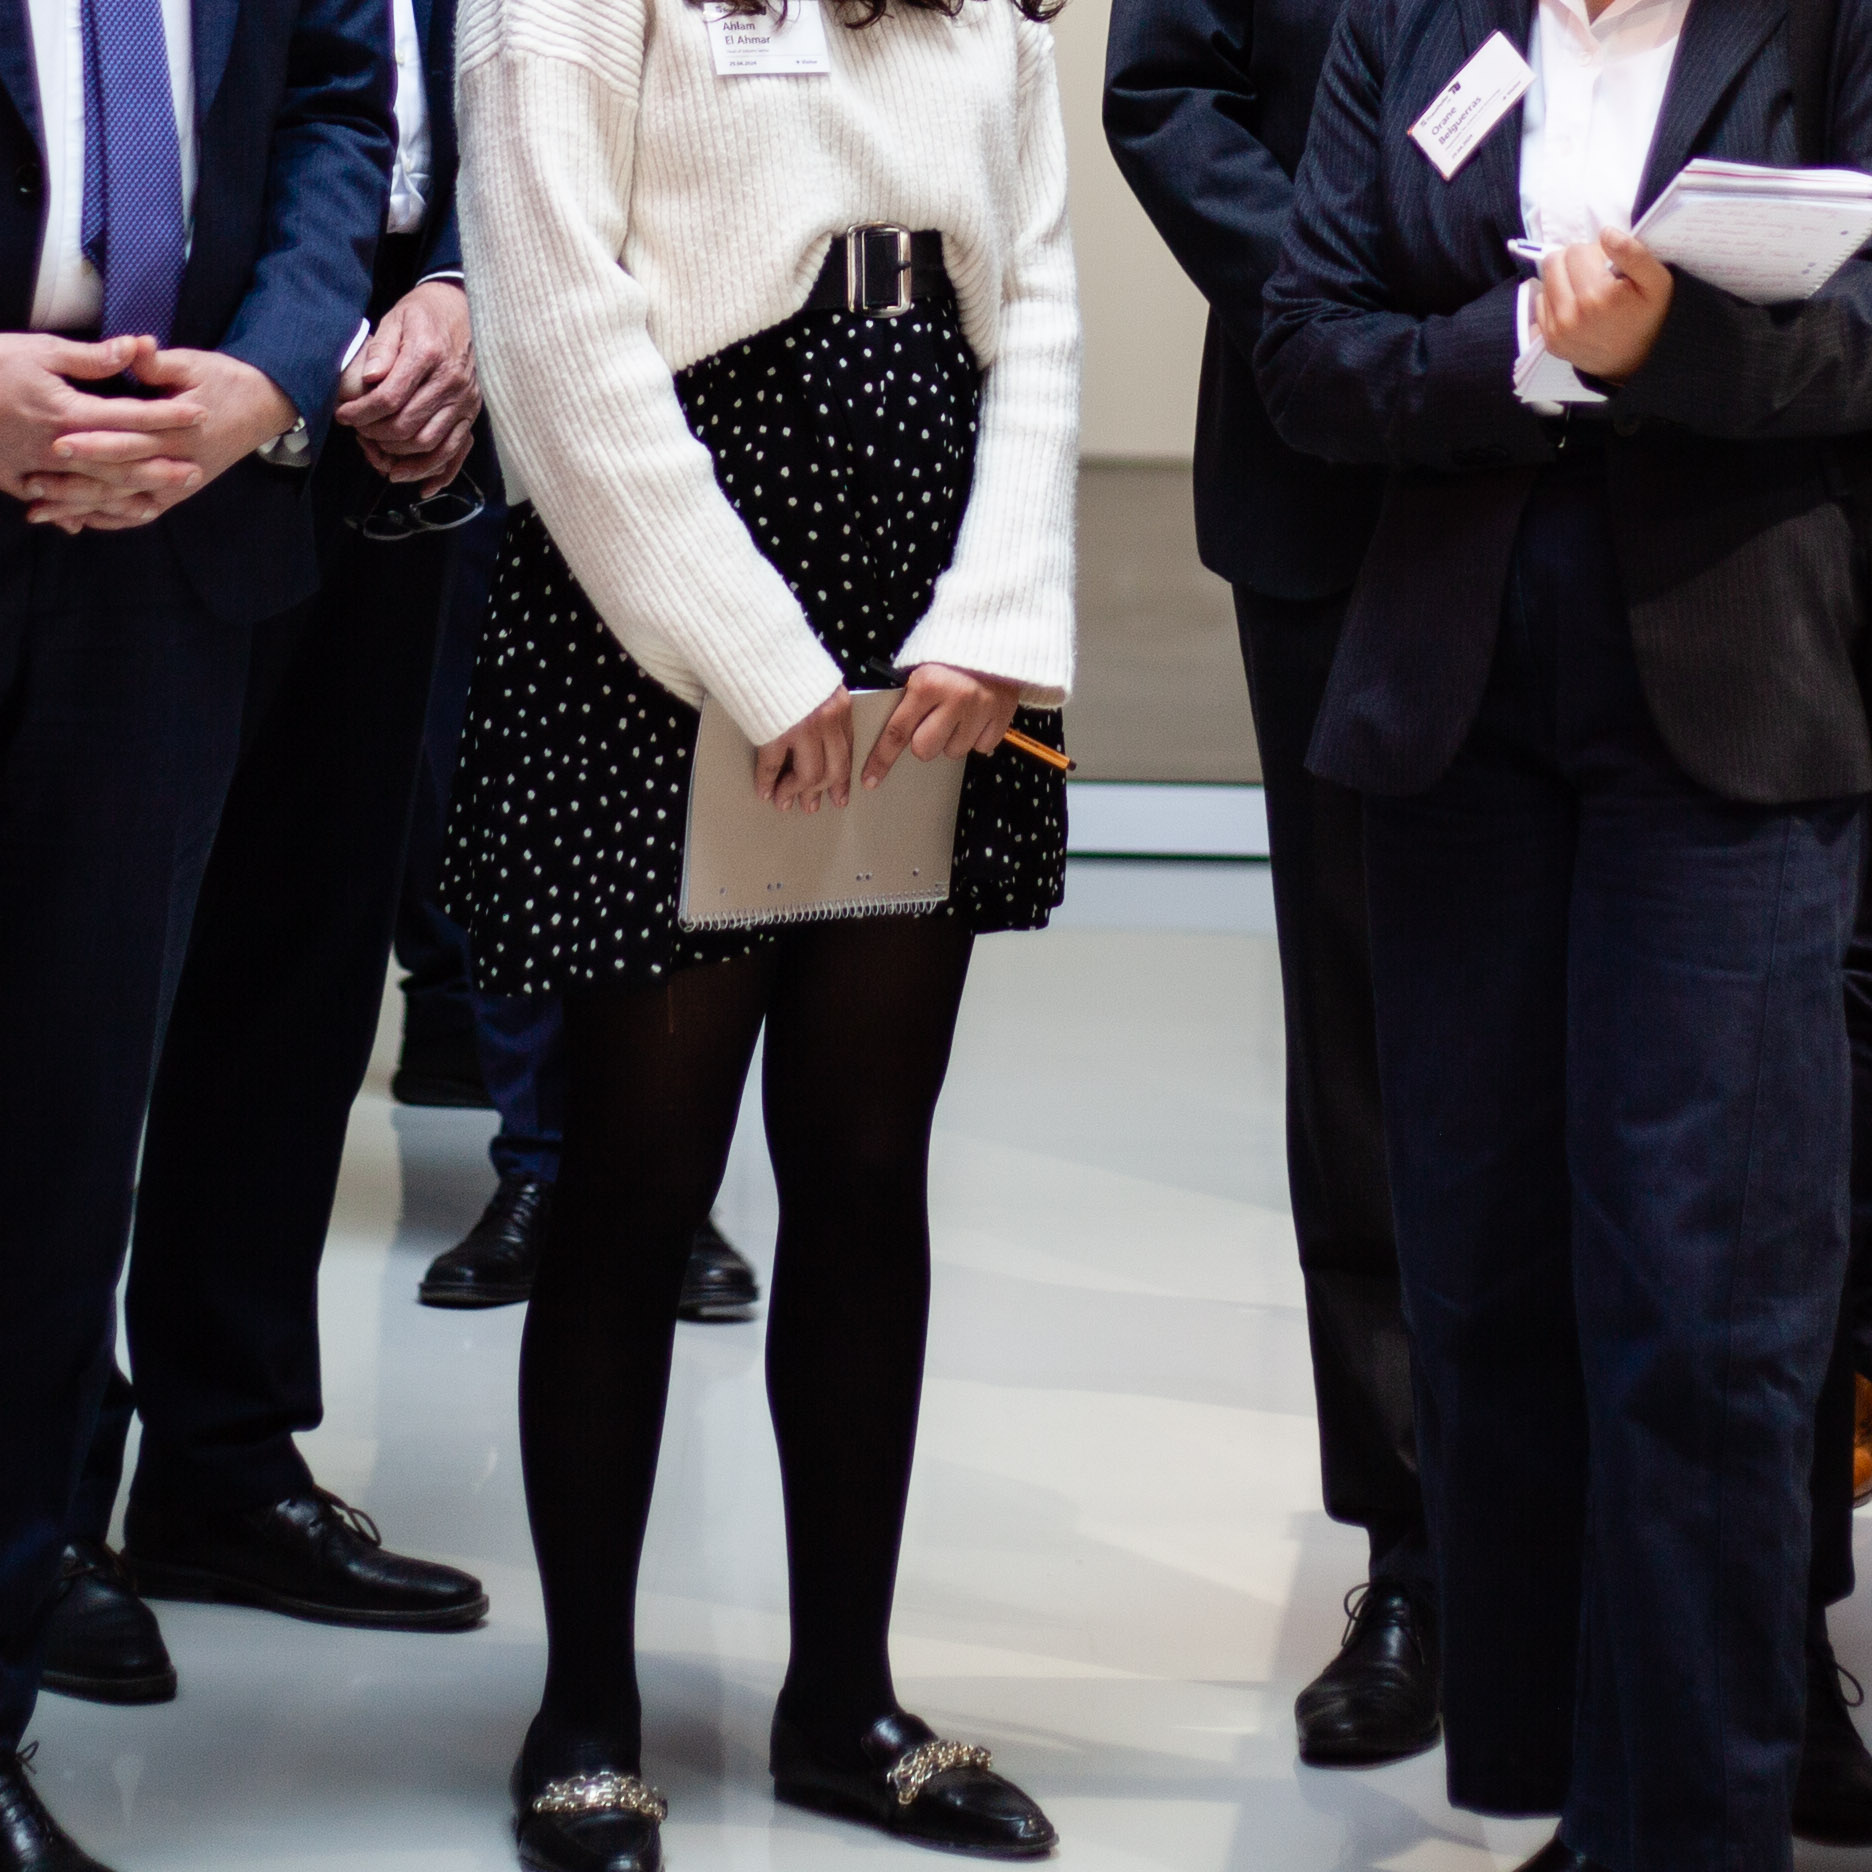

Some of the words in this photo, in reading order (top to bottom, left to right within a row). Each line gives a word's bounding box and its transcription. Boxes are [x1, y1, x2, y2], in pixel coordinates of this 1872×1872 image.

[723, 20, 756, 31] Ahlam
[725, 35, 734, 46] El
[737, 35, 771, 45] Ahmar
[1431, 106, 1458, 136] Orane
